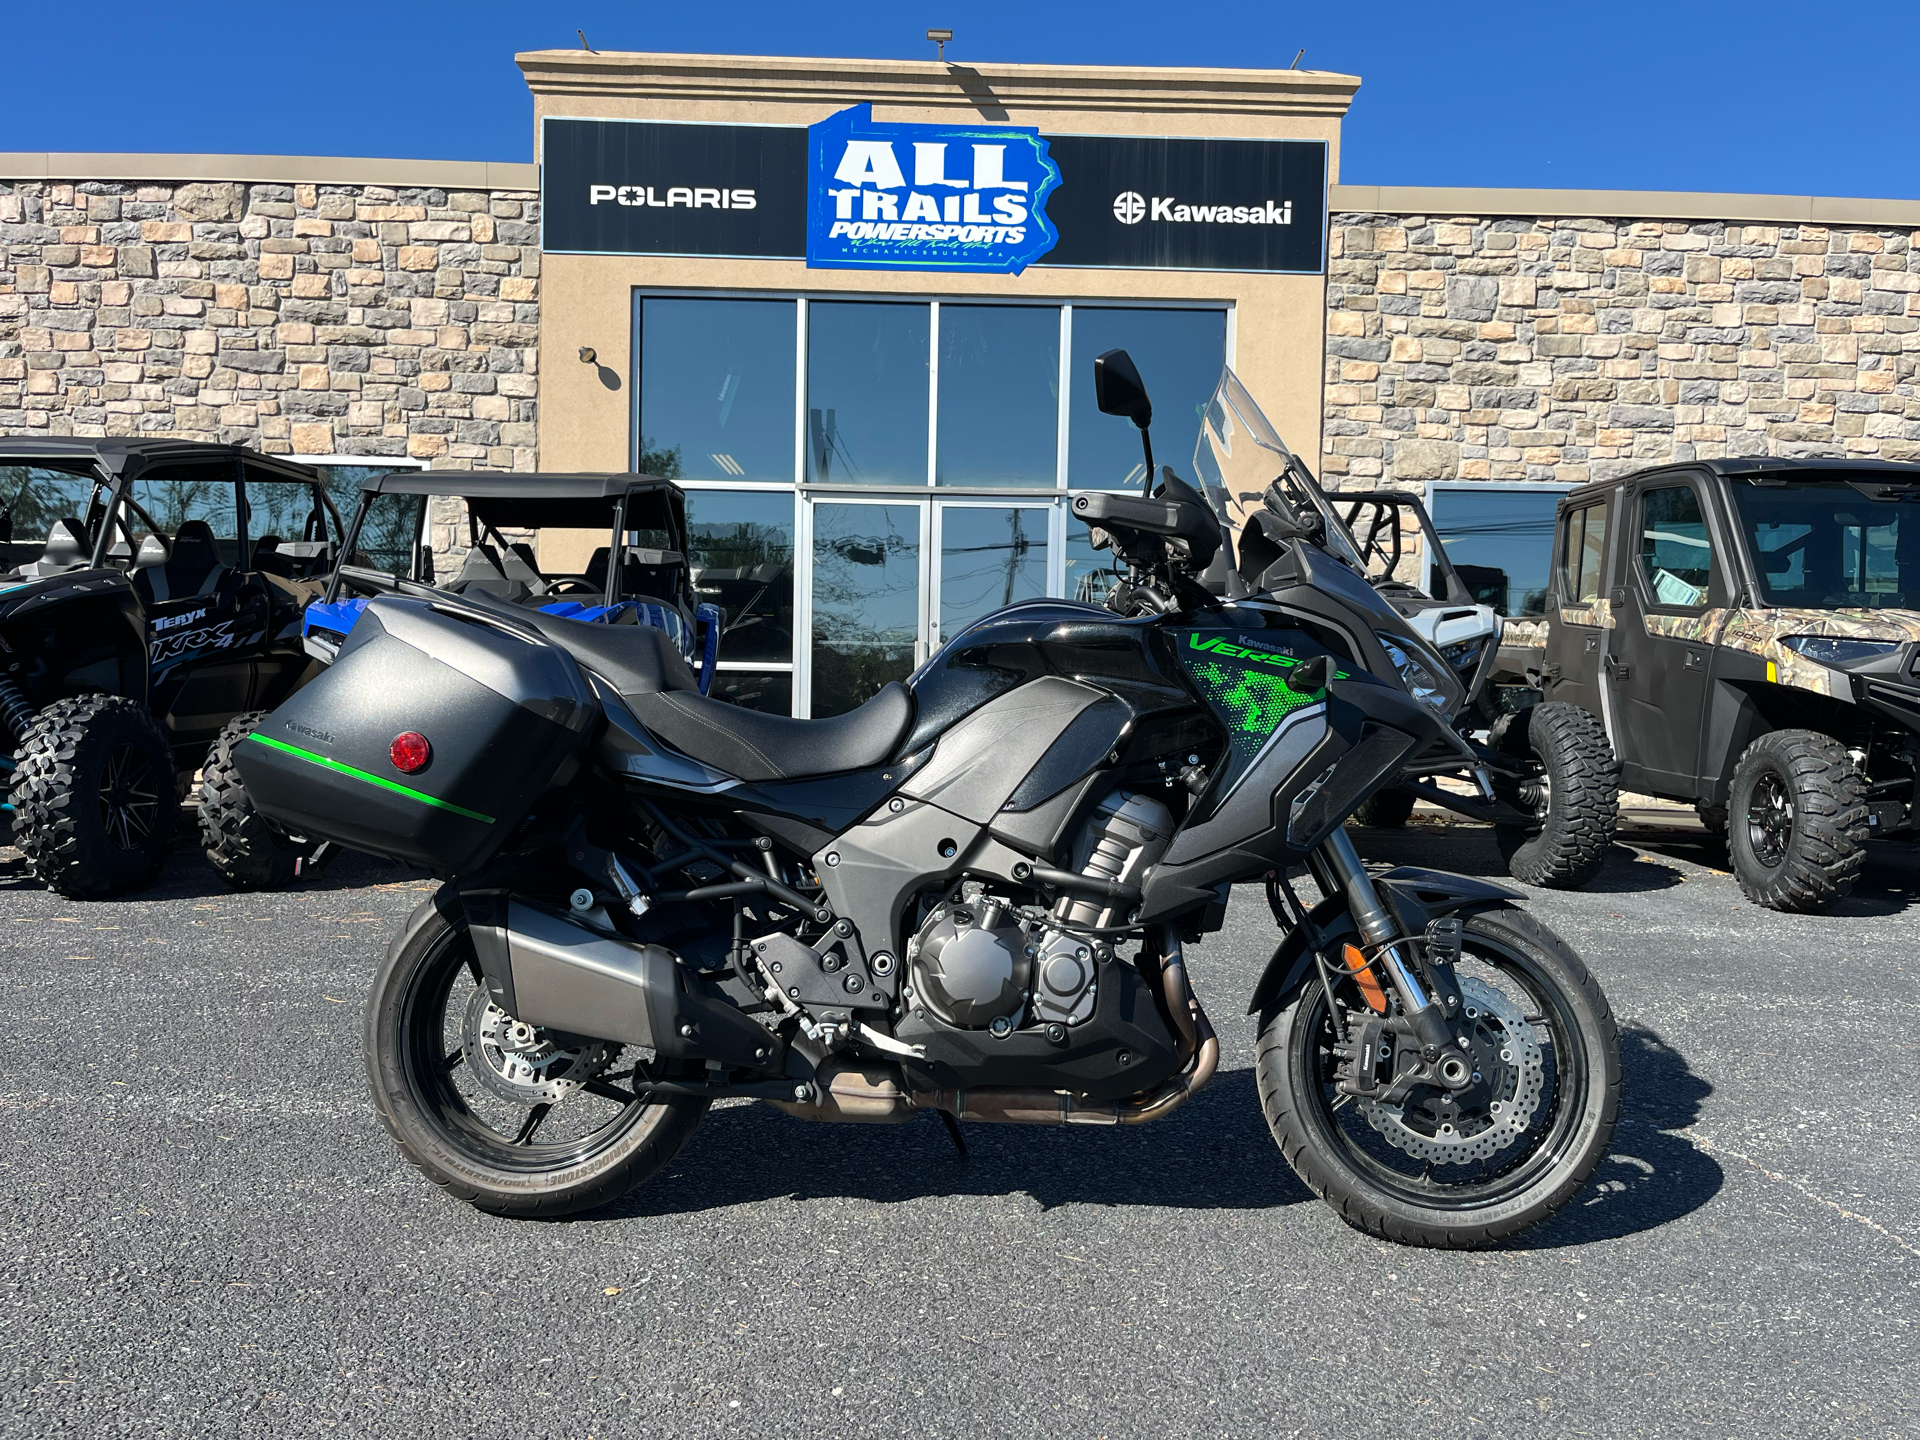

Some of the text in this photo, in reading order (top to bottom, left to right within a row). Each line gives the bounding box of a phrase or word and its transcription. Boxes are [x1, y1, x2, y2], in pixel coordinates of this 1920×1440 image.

[834, 140, 1028, 193] ALL
[590, 184, 757, 210] POLARIS
[828, 188, 1028, 225] TRAILS
[1151, 196, 1293, 225] Kawasaki
[828, 221, 1027, 245] POWERSPORTS
[1237, 634, 1294, 657] Kawasaki
[1731, 629, 1763, 643] 1000
[284, 719, 337, 745] Kawasaki
[549, 1138, 632, 1187] BRIDGESTONE
